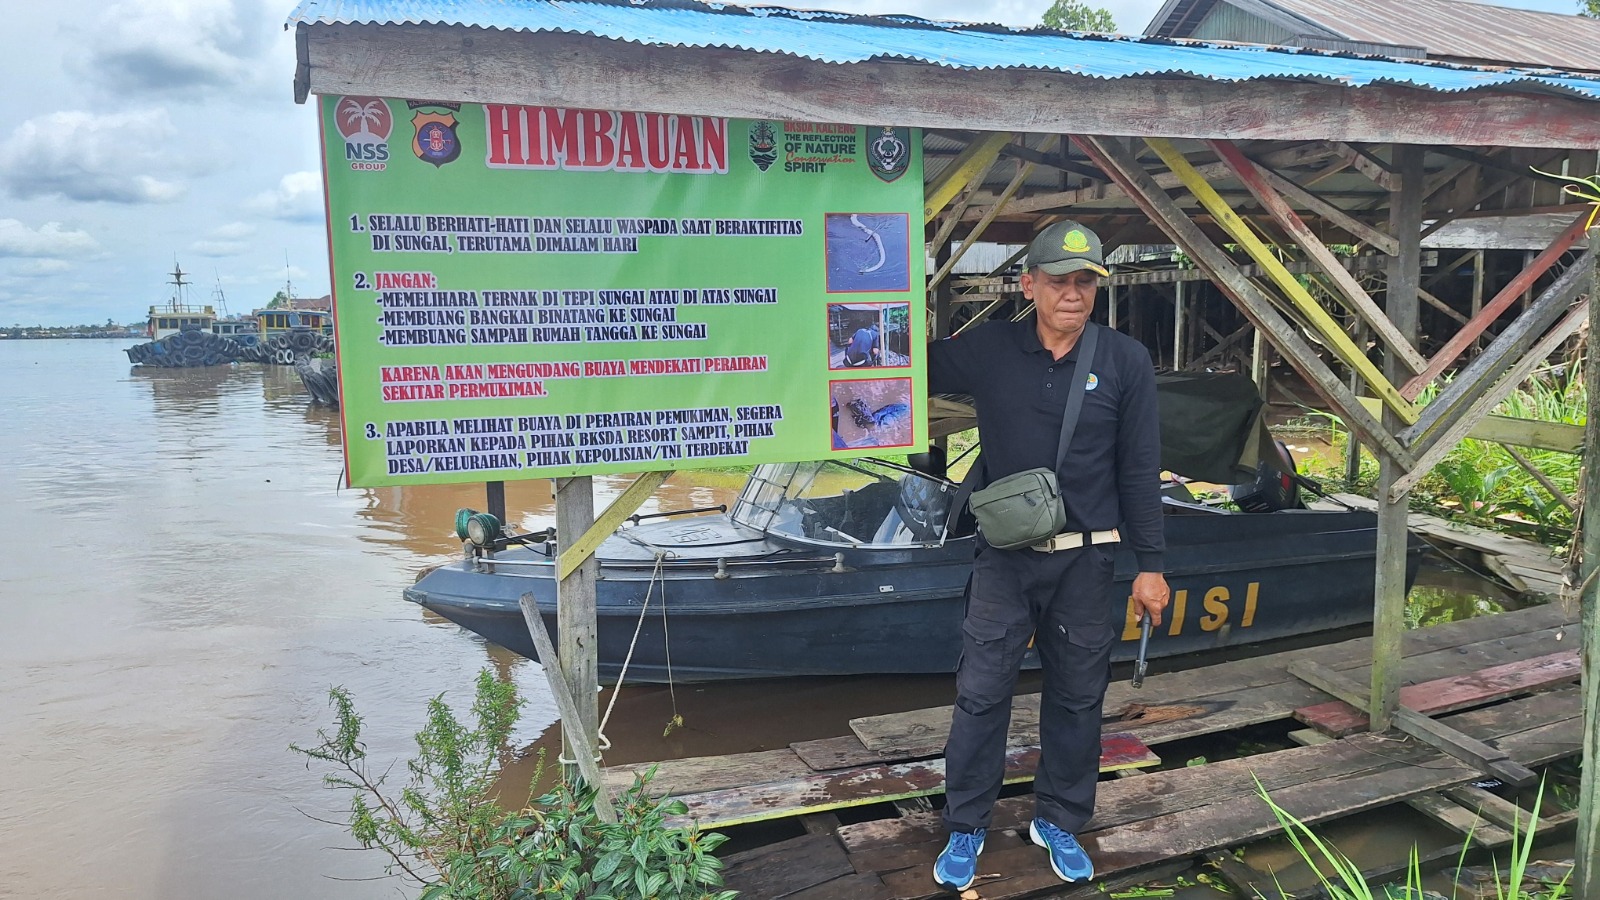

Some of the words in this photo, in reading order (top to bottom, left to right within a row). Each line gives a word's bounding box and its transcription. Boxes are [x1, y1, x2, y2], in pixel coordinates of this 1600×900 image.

[488, 104, 725, 169] HIMBAUAN
[802, 134, 856, 142] REFLECTION
[346, 143, 388, 160] NSS
[784, 142, 802, 152] OF
[806, 143, 856, 154] NATURE
[351, 162, 386, 170] GROUP
[786, 152, 856, 163] Conservation
[784, 162, 826, 172] SPIRIT
[350, 216, 364, 232] 1.
[370, 216, 421, 232] SELALU
[426, 217, 529, 233] BERHATI-HATI
[534, 218, 561, 234] DAN
[566, 219, 612, 234] SELALU
[616, 220, 678, 234] WASPADA
[682, 220, 713, 234] SAAT
[716, 220, 802, 235] BERAKTIFITAS
[373, 236, 390, 250] DI
[395, 236, 452, 254] SUNGAI,
[457, 236, 532, 252] TERUTAMA
[536, 237, 599, 252] DIMALAM
[603, 238, 637, 252] HARI
[355, 274, 370, 288] 2.
[376, 274, 436, 290] JANGAN:
[376, 292, 478, 307] -MEMELIHARA
[482, 292, 538, 306] TERNAK
[542, 292, 558, 306] DI
[562, 291, 595, 306] TEPI
[600, 291, 644, 305] SUNGAI
[649, 290, 679, 304] ATAU
[683, 290, 698, 304] DI
[702, 290, 730, 304] ATAS
[734, 289, 776, 303] SUNGAI
[378, 310, 465, 326] -MEMBUANG
[470, 310, 534, 325] BANGKAI
[538, 309, 604, 324] BINATANG
[609, 308, 626, 322] KE
[630, 308, 676, 322] SUNGAI
[379, 329, 466, 344] -MEMBUANG
[471, 328, 528, 344] SAMPAH
[532, 327, 580, 342] RUMAH
[584, 326, 637, 341] TANGGA
[642, 325, 658, 340] KE
[662, 324, 706, 339] SUNGAI
[382, 366, 440, 382] KARENA
[445, 365, 482, 380] AKAN
[488, 363, 580, 380] MENGUNDANG
[584, 361, 626, 376] BUAYA
[630, 358, 701, 374] MENDEKATI
[704, 356, 767, 372] PERAIRAN
[383, 384, 444, 400] SEKITAR
[449, 382, 547, 398] PERMUKIMAN.
[366, 424, 381, 438] 3.
[386, 421, 449, 437] APABILA
[453, 418, 513, 434] MELIHAT
[518, 416, 562, 432] BUAYA
[566, 415, 581, 430] DI
[586, 412, 652, 429] PERAIRAN
[656, 408, 732, 424] PEMUKIMAN,
[736, 406, 782, 420] SEGERA
[388, 438, 466, 456] LAPORKAN
[470, 436, 526, 451] KEPADA
[531, 433, 576, 449] PIHAK
[580, 431, 624, 446] BKSDA
[628, 428, 678, 444] RESORT
[682, 426, 730, 440] SAMPIT,
[734, 423, 774, 438] PIHAK
[388, 454, 522, 474] DESA/KELURAHAN,
[526, 452, 570, 466] PIHAK
[575, 445, 682, 464] KEPOLISIAN/TNI
[686, 441, 749, 457] TERDEKAT
